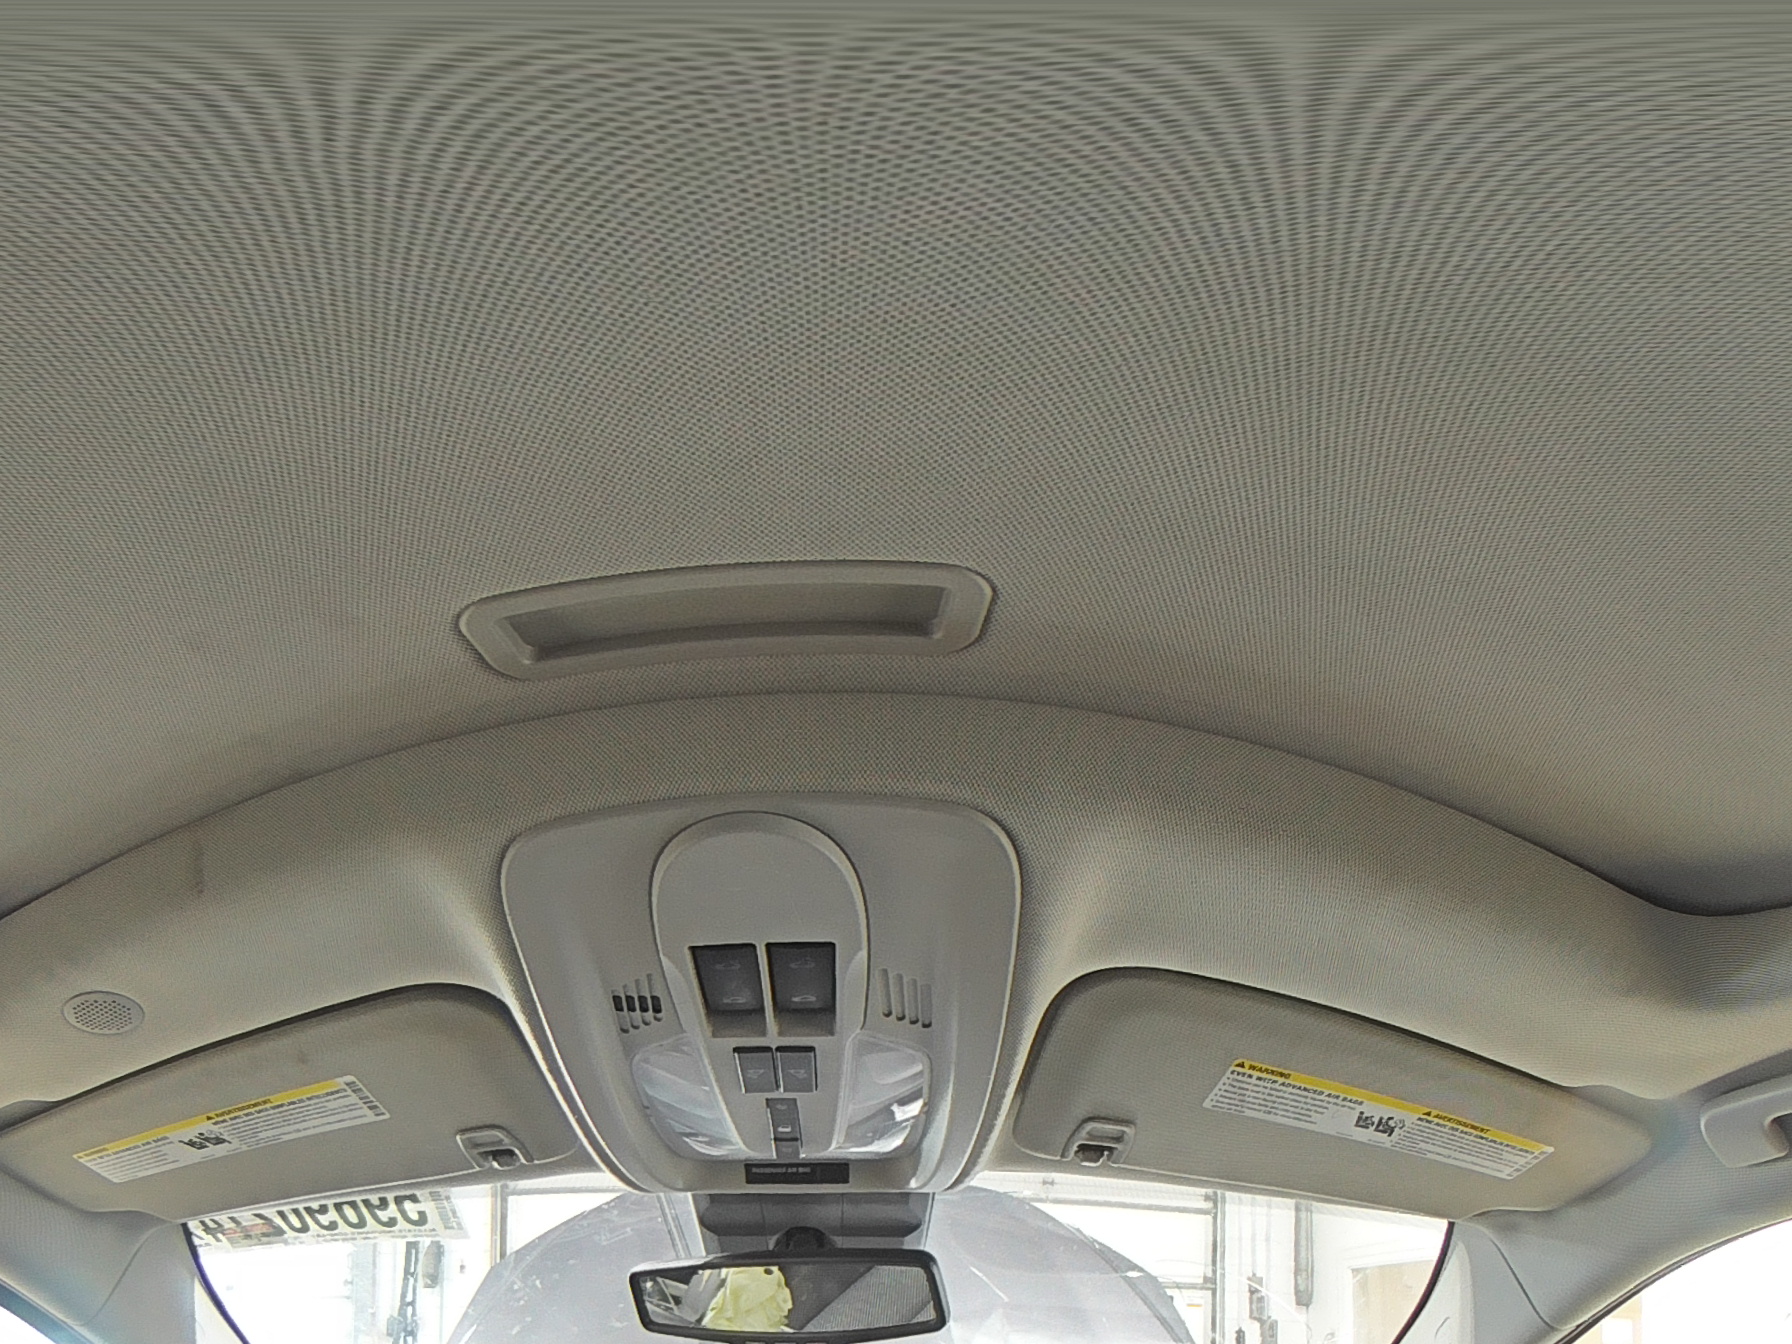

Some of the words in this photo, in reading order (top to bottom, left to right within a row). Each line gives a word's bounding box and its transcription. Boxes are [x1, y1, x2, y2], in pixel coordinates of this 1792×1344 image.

[1248, 1063, 1292, 1079] WARNING
[1230, 1070, 1253, 1079] EVEN
[1255, 1075, 1279, 1085] WITH
[1279, 1081, 1325, 1096] ADVANCED
[1324, 1092, 1340, 1100] AIR
